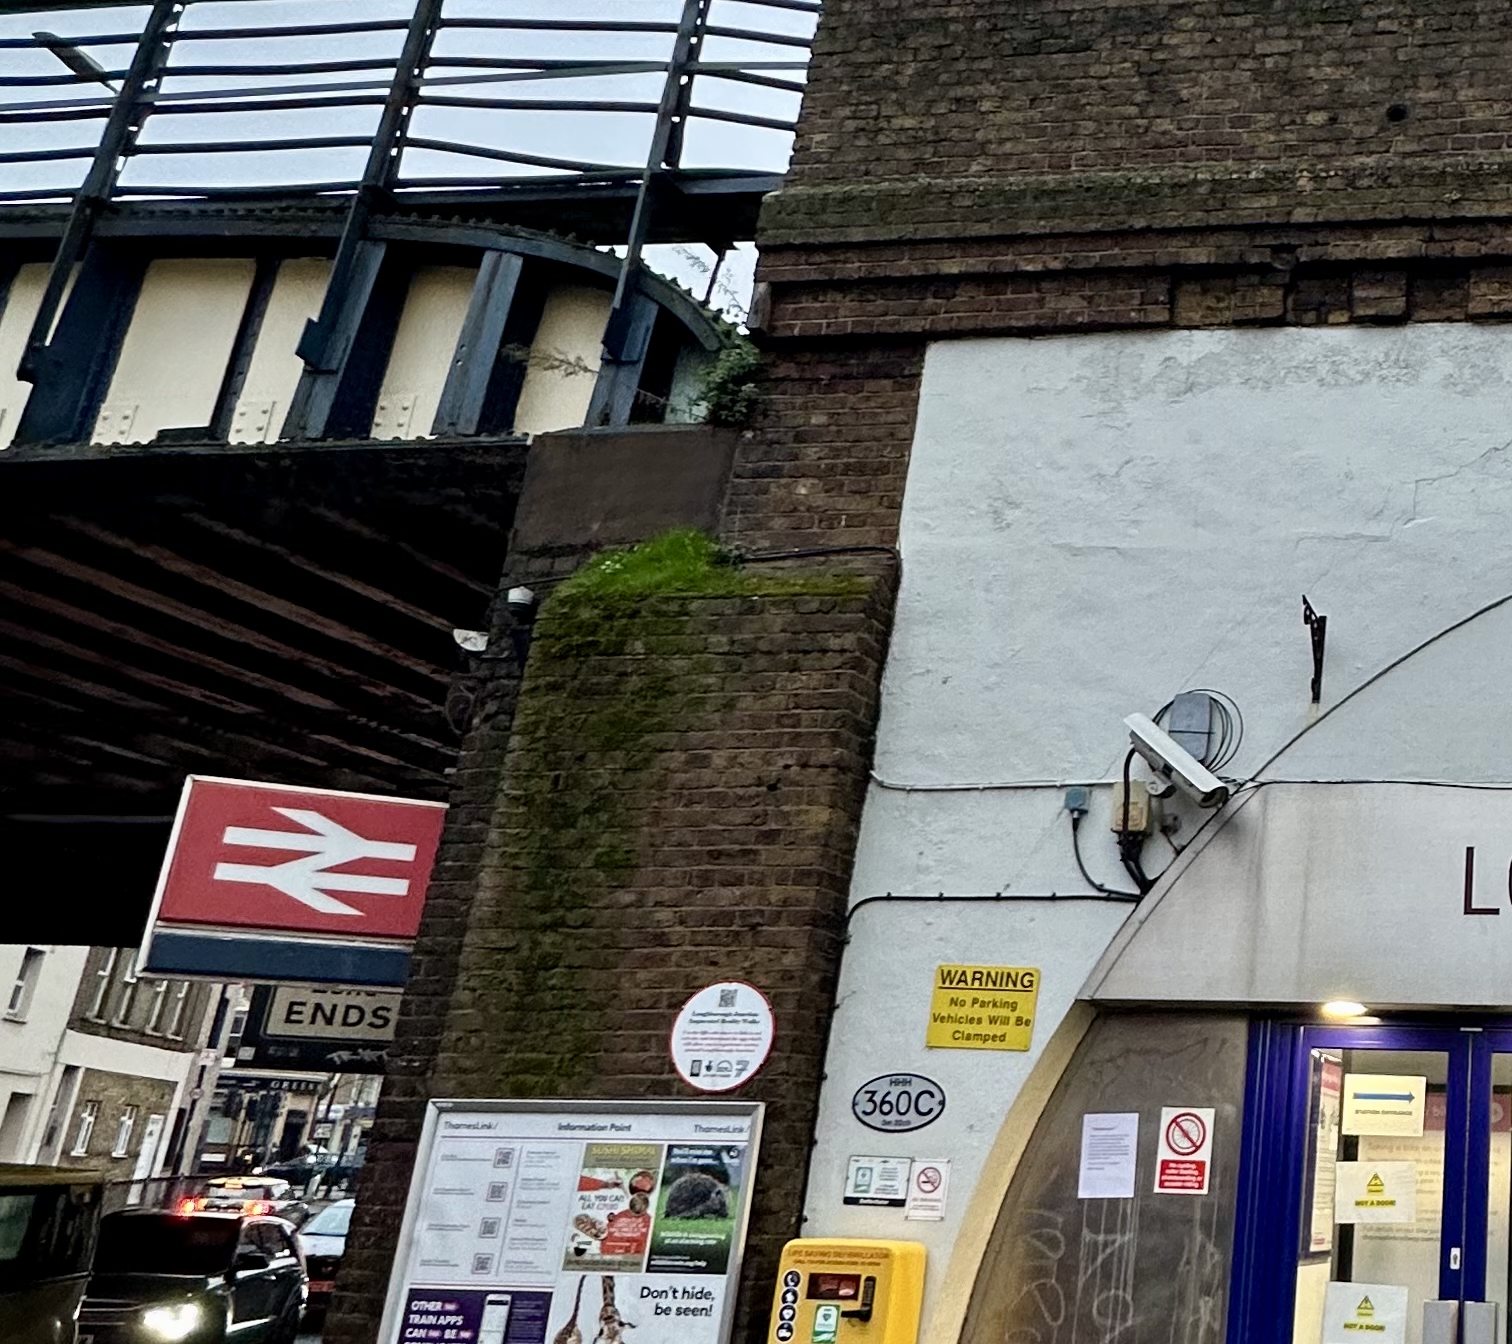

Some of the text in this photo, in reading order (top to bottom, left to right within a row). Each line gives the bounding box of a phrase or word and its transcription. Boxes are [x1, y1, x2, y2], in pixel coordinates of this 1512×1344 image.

[940, 968, 1035, 989] WARNING
[949, 997, 1019, 1012] No Parking
[284, 1001, 392, 1029] ENDS
[932, 1012, 1032, 1028] Vehicles Will Be
[952, 1030, 1008, 1044] Clamped
[861, 1089, 936, 1117] 360C
[557, 1123, 632, 1132] Information Point
[640, 1286, 715, 1301] Don't hide,
[411, 1300, 442, 1312] OTHER
[654, 1303, 713, 1317] be seen!
[408, 1314, 465, 1326] TRAIN APPS
[405, 1328, 458, 1339] CAN BE
